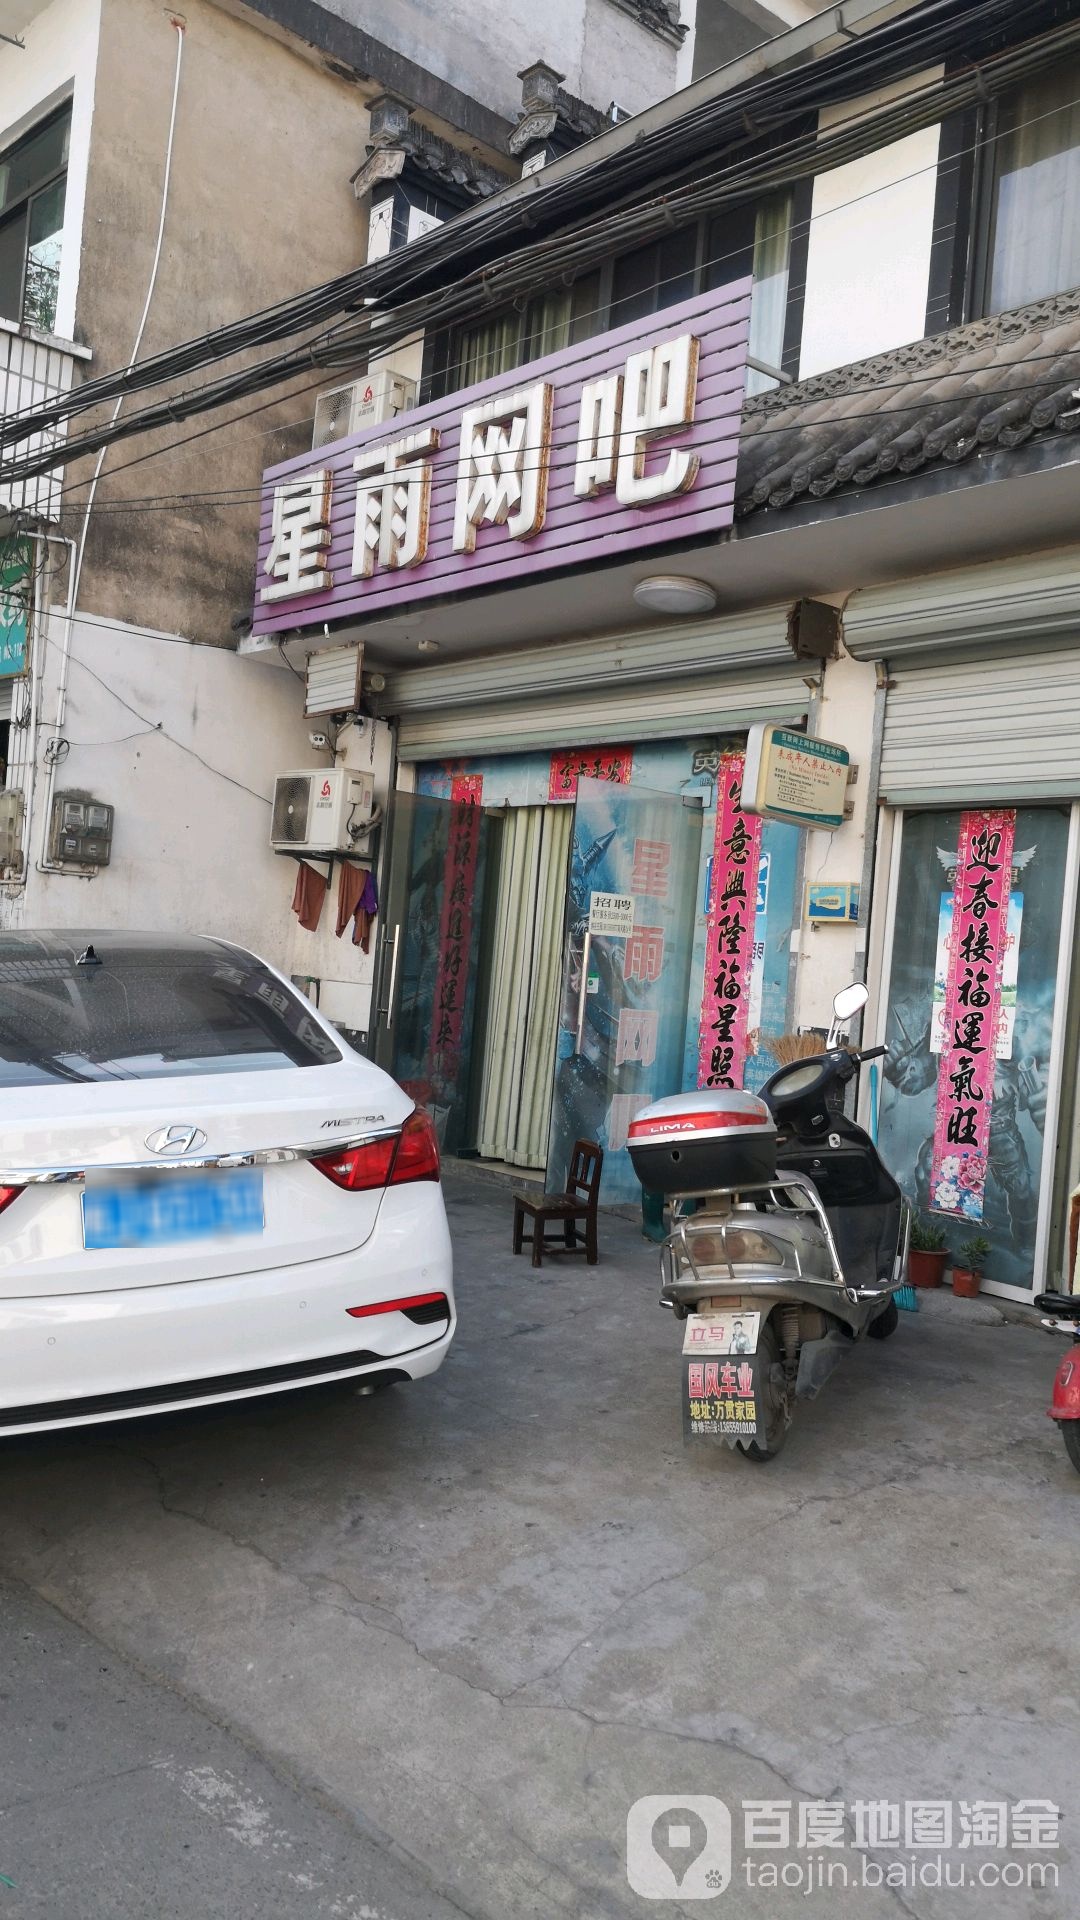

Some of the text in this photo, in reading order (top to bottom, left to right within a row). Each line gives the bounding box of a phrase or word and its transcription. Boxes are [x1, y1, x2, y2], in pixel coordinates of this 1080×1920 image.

[260, 334, 701, 604] 星雨网吧
[777, 749, 842, 777] 未成年人禁止入内
[594, 896, 632, 911] 招聘
[320, 1115, 385, 1128] MISTRA
[650, 1122, 696, 1133] LIMA
[690, 1326, 725, 1342] 立马
[688, 1361, 755, 1399] 国风车业
